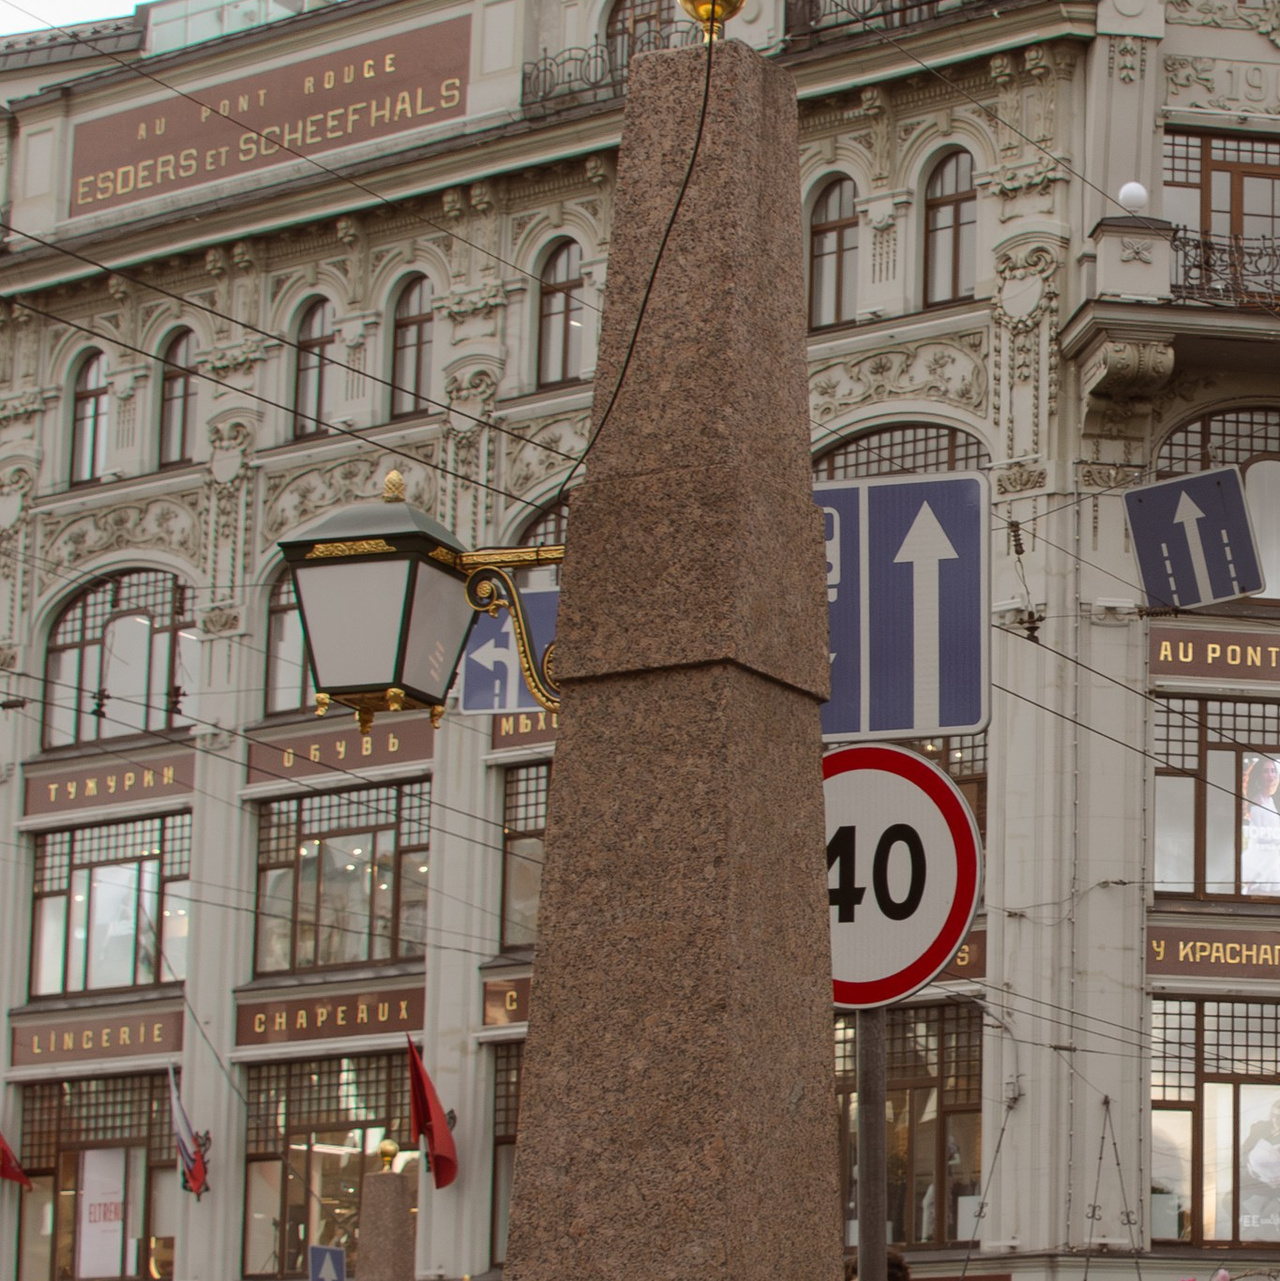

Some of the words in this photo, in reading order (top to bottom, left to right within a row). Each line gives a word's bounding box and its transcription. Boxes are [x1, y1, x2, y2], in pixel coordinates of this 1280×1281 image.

[136, 116, 166, 141] AU
[201, 89, 268, 122] PONT
[303, 53, 397, 95] ROUGE
[76, 148, 198, 206] ESDERS
[204, 146, 231, 172] ET
[238, 77, 462, 162] SCHEEFHALS
[1158, 640, 1194, 663] AU
[1206, 643, 1280, 668] PONT
[281, 733, 400, 768] ОБУВЬ
[48, 765, 175, 802] ТУЖУРКИ
[826, 823, 927, 924] 40
[1152, 939, 1165, 962] У
[254, 999, 409, 1033] CHAPEAUX
